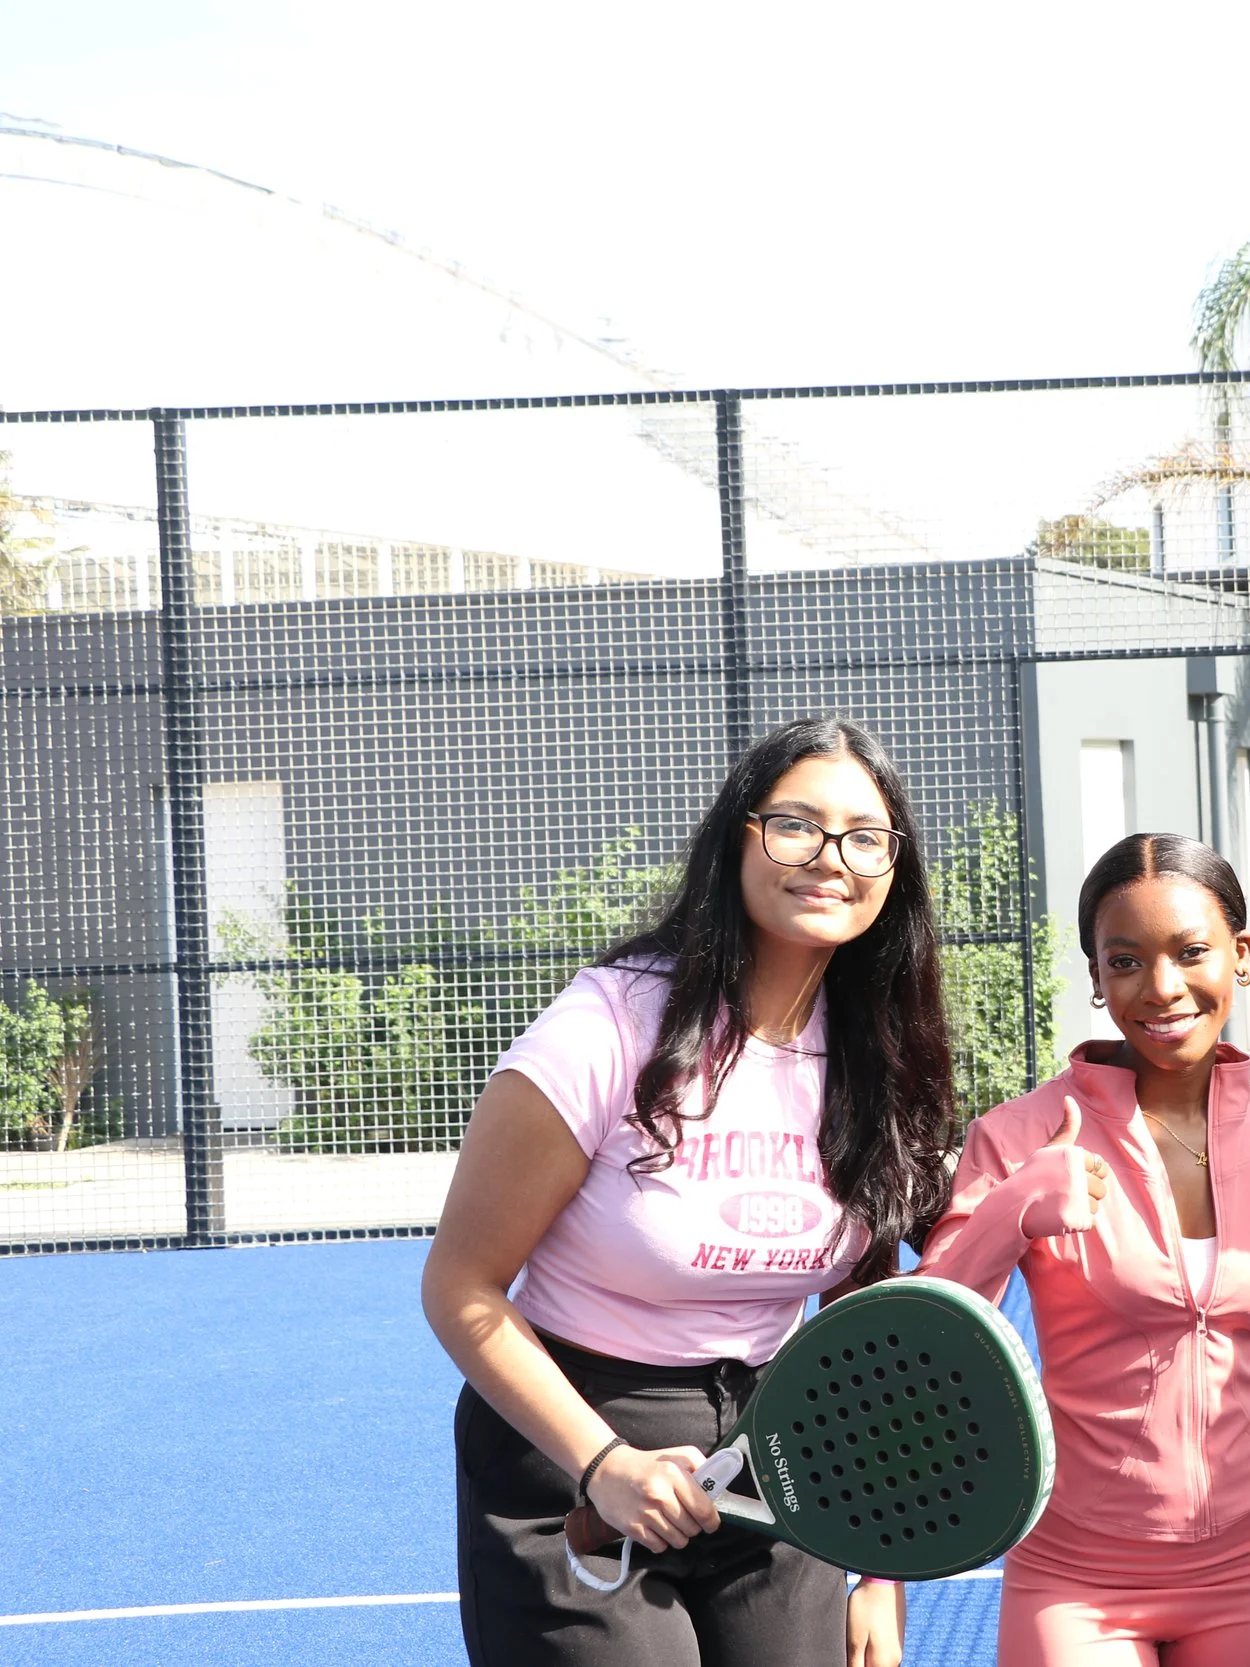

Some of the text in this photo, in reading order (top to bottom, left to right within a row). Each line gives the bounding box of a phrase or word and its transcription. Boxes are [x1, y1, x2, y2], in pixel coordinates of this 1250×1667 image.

[675, 1131, 816, 1184] BROOKL
[738, 1195, 803, 1233] 1998
[691, 1243, 830, 1271] NEW YORK
[765, 1432, 800, 1513] No Strings
